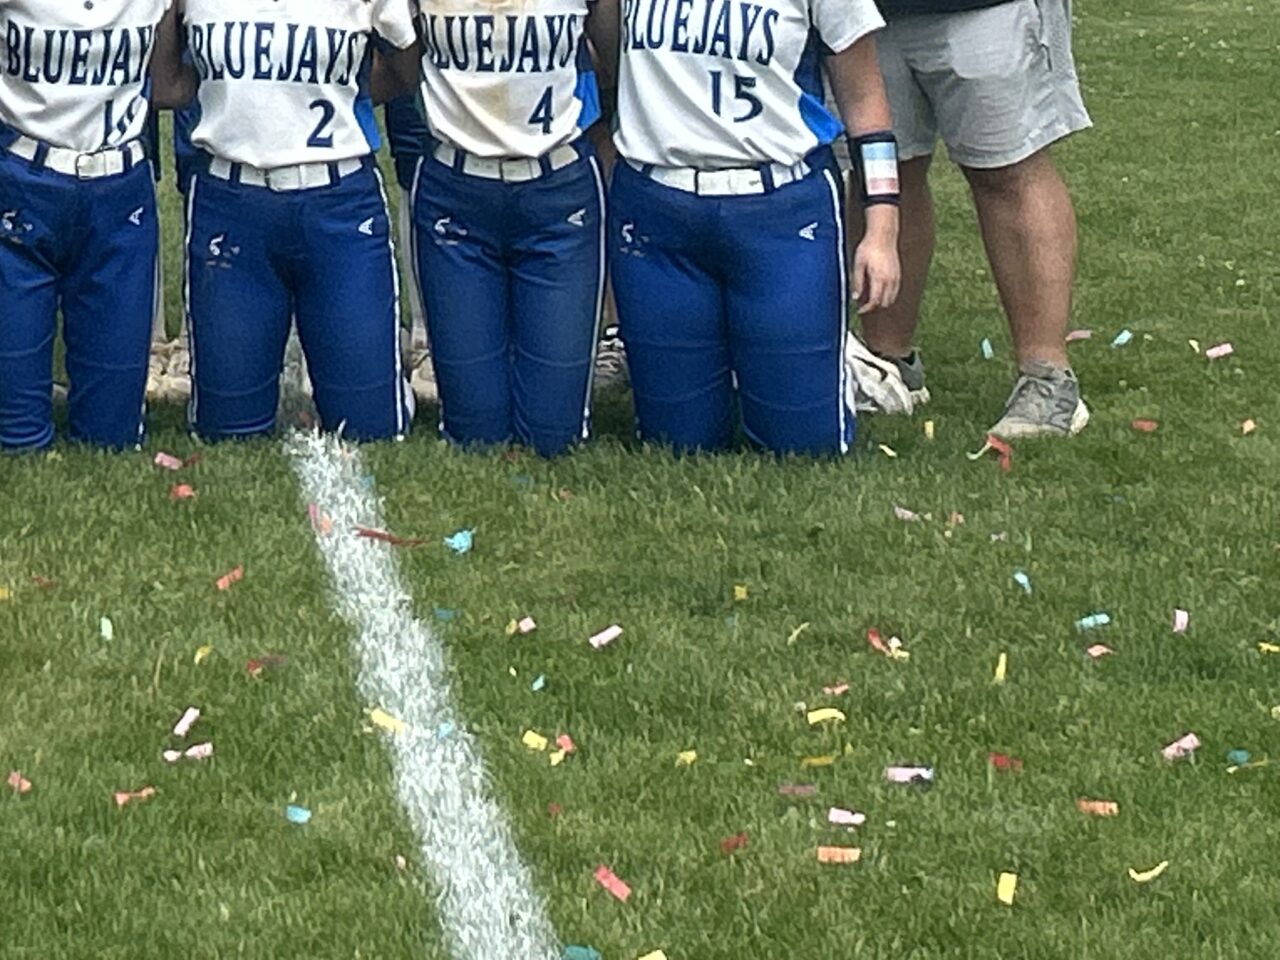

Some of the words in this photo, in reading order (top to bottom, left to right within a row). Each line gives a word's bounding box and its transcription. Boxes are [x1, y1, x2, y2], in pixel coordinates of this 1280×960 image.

[6, 19, 154, 86] BLUEJAY
[528, 85, 554, 135] 4
[708, 70, 764, 123] 15
[306, 98, 335, 148] 2
